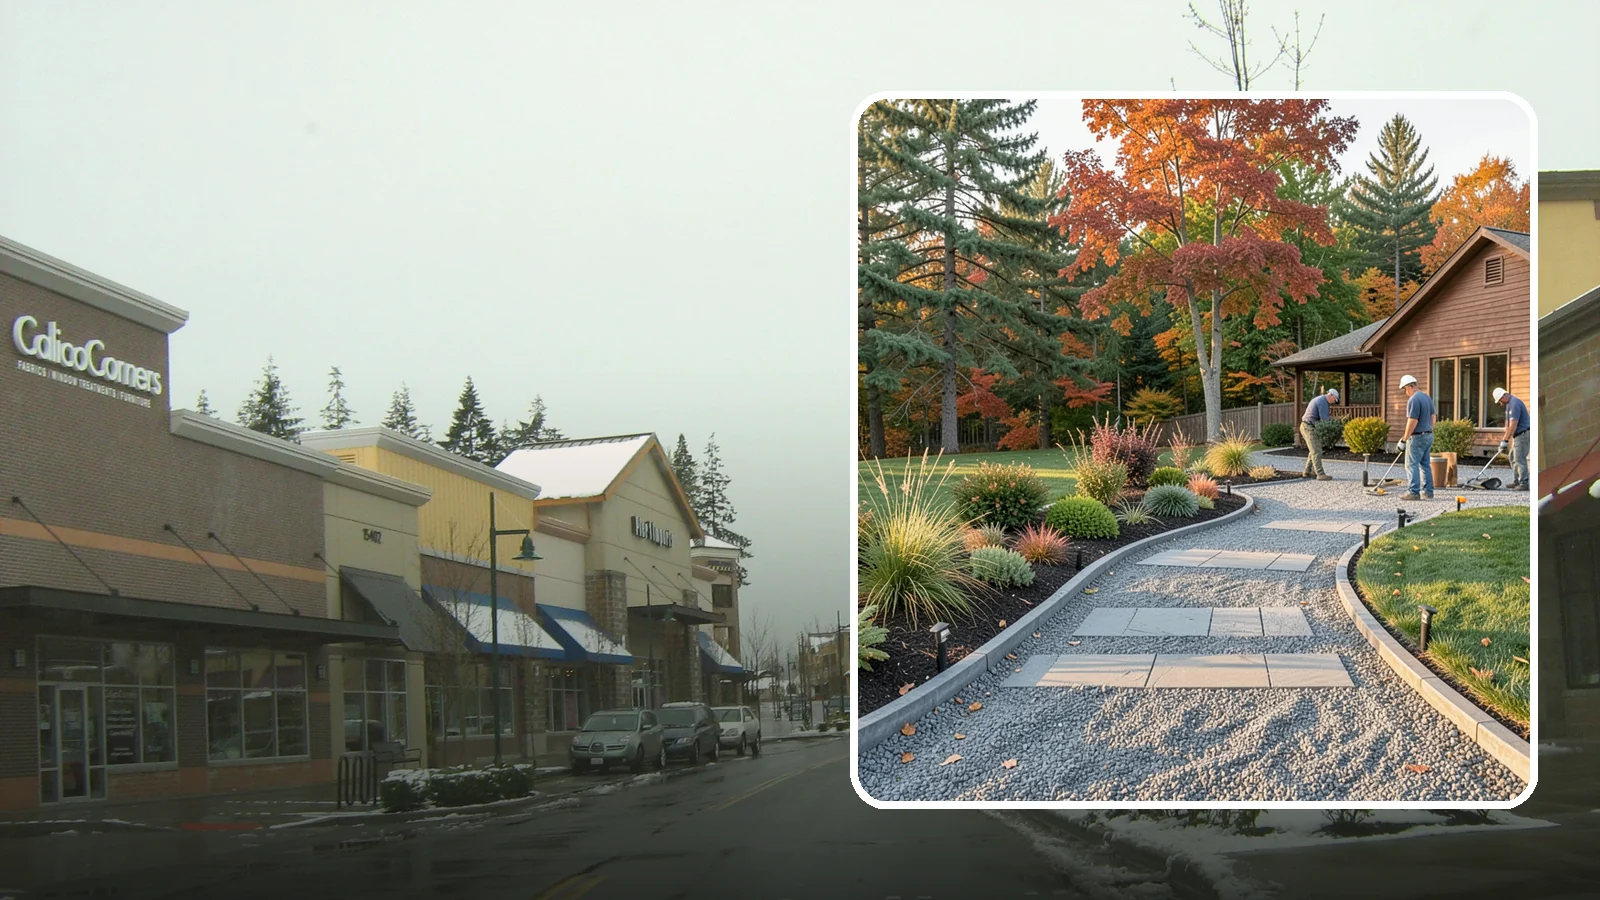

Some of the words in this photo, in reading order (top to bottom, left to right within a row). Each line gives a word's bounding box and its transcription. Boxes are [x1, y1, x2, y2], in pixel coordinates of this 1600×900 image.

[17, 360, 47, 378] FABRICS
[51, 370, 78, 387] WINDOW
[79, 379, 117, 399] TREATMENTS
[120, 391, 151, 409] FURNITURE
